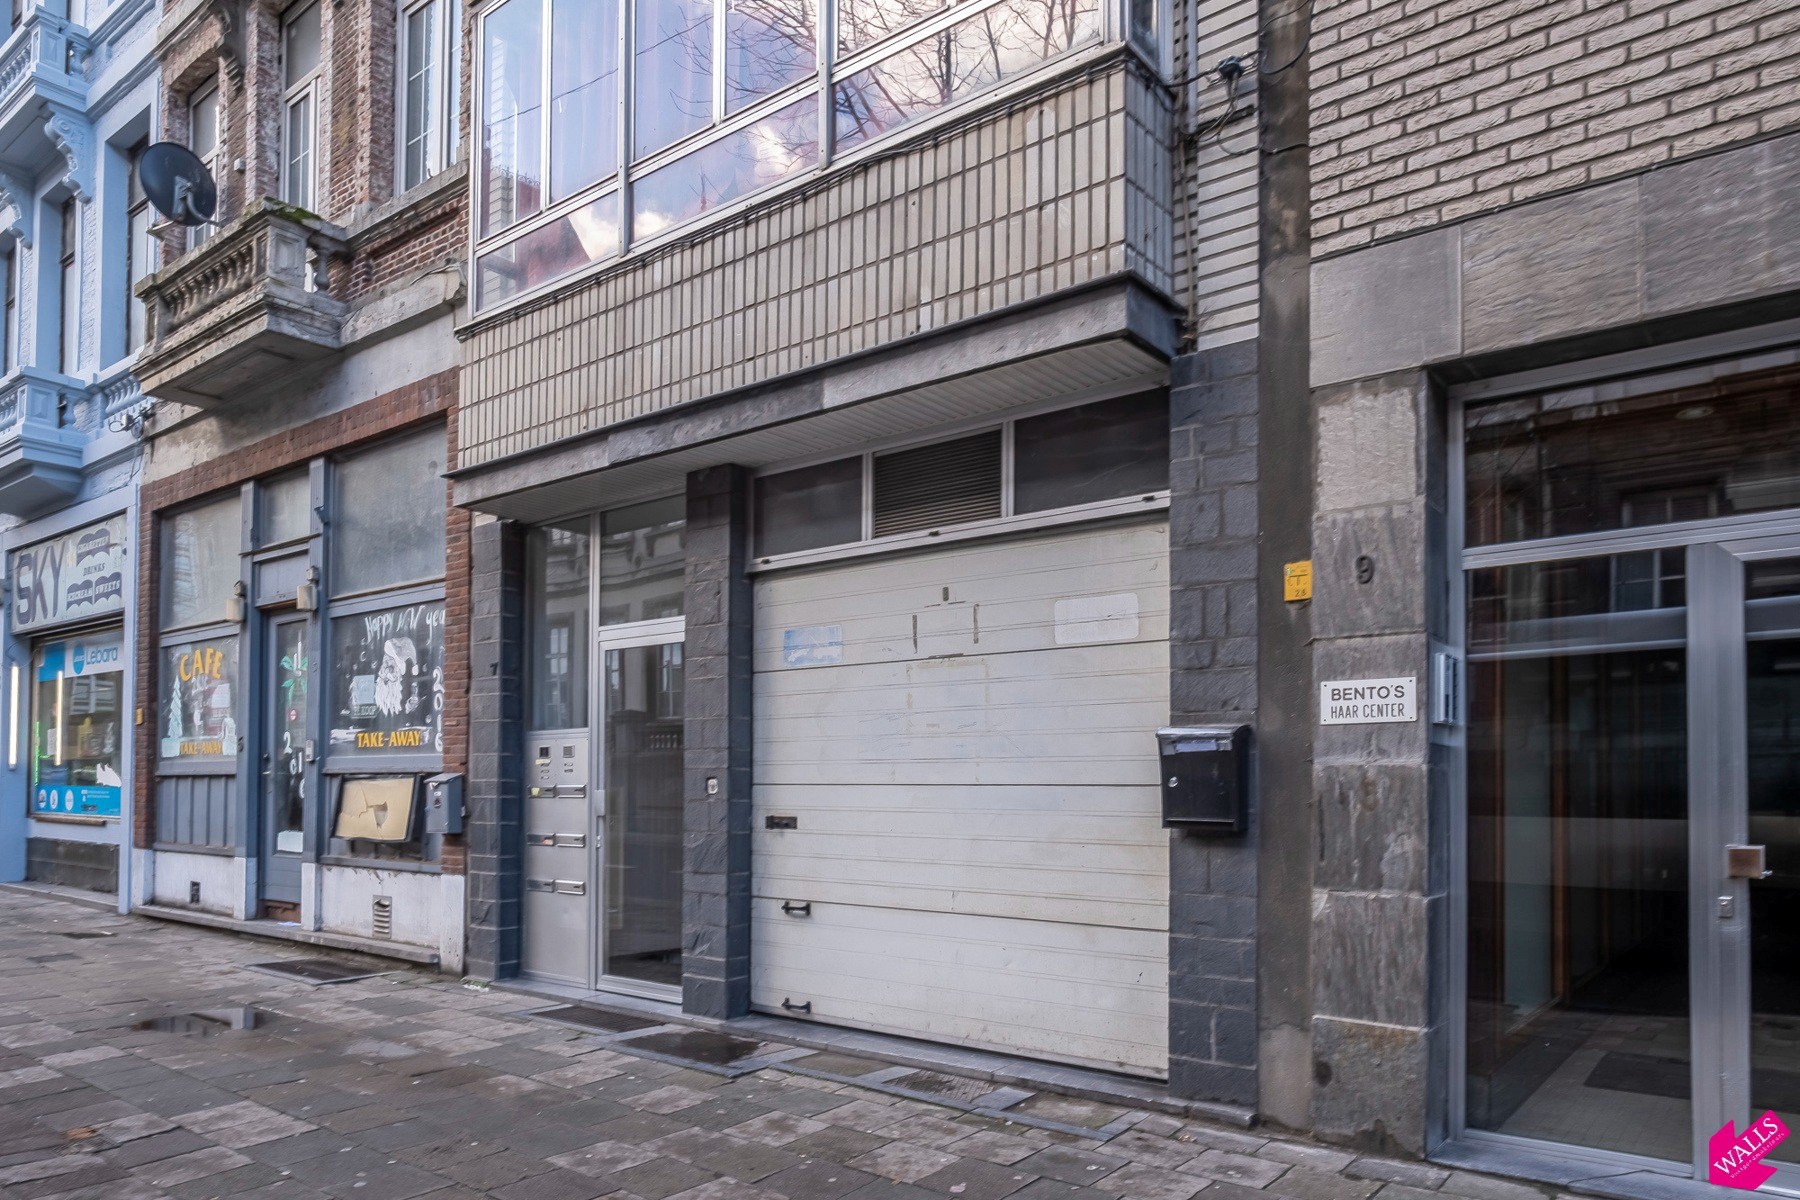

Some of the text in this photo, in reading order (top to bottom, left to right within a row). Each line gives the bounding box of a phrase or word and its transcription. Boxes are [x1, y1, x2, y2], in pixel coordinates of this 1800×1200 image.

[16, 540, 66, 625] SKY
[1355, 554, 1376, 584] 9
[180, 648, 223, 681] CAFE
[1331, 685, 1405, 701] BENTO'S
[1331, 703, 1405, 719] HAAR CENTER
